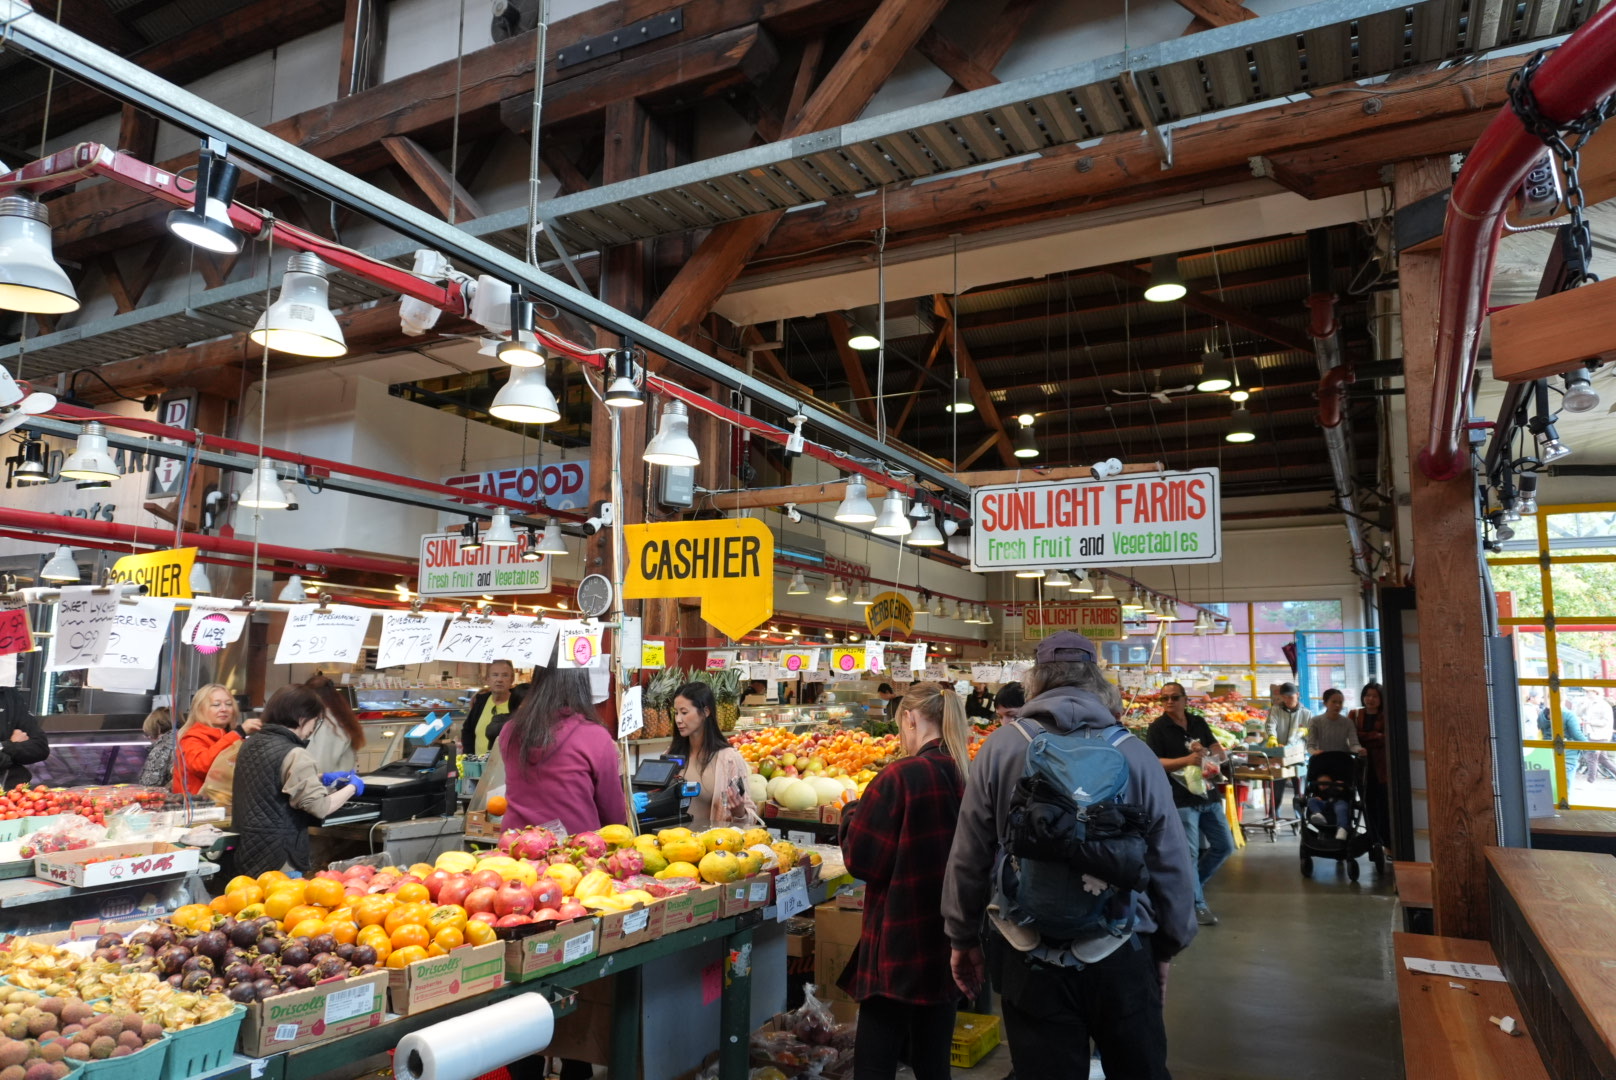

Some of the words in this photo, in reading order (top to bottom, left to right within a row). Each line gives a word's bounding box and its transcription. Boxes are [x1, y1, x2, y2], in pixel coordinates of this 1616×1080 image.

[981, 486, 1105, 532] SUNLIGHT
[1115, 479, 1207, 525] FARMS
[640, 535, 761, 581] CASHIER
[988, 538, 1026, 561] Fresh
[1033, 535, 1072, 558] Fruit
[1079, 534, 1105, 556] and
[1112, 530, 1198, 555] Vegetables
[428, 572, 449, 589] Fresh
[452, 571, 475, 588] Fruit
[477, 570, 492, 587] and
[495, 569, 540, 586] Vegetables
[868, 599, 890, 630] HERB
[889, 599, 913, 631] CENTRE
[1027, 608, 1079, 626] SUNLIGHT
[1082, 607, 1118, 625] FARMS
[417, 957, 462, 978] Driscoll's
